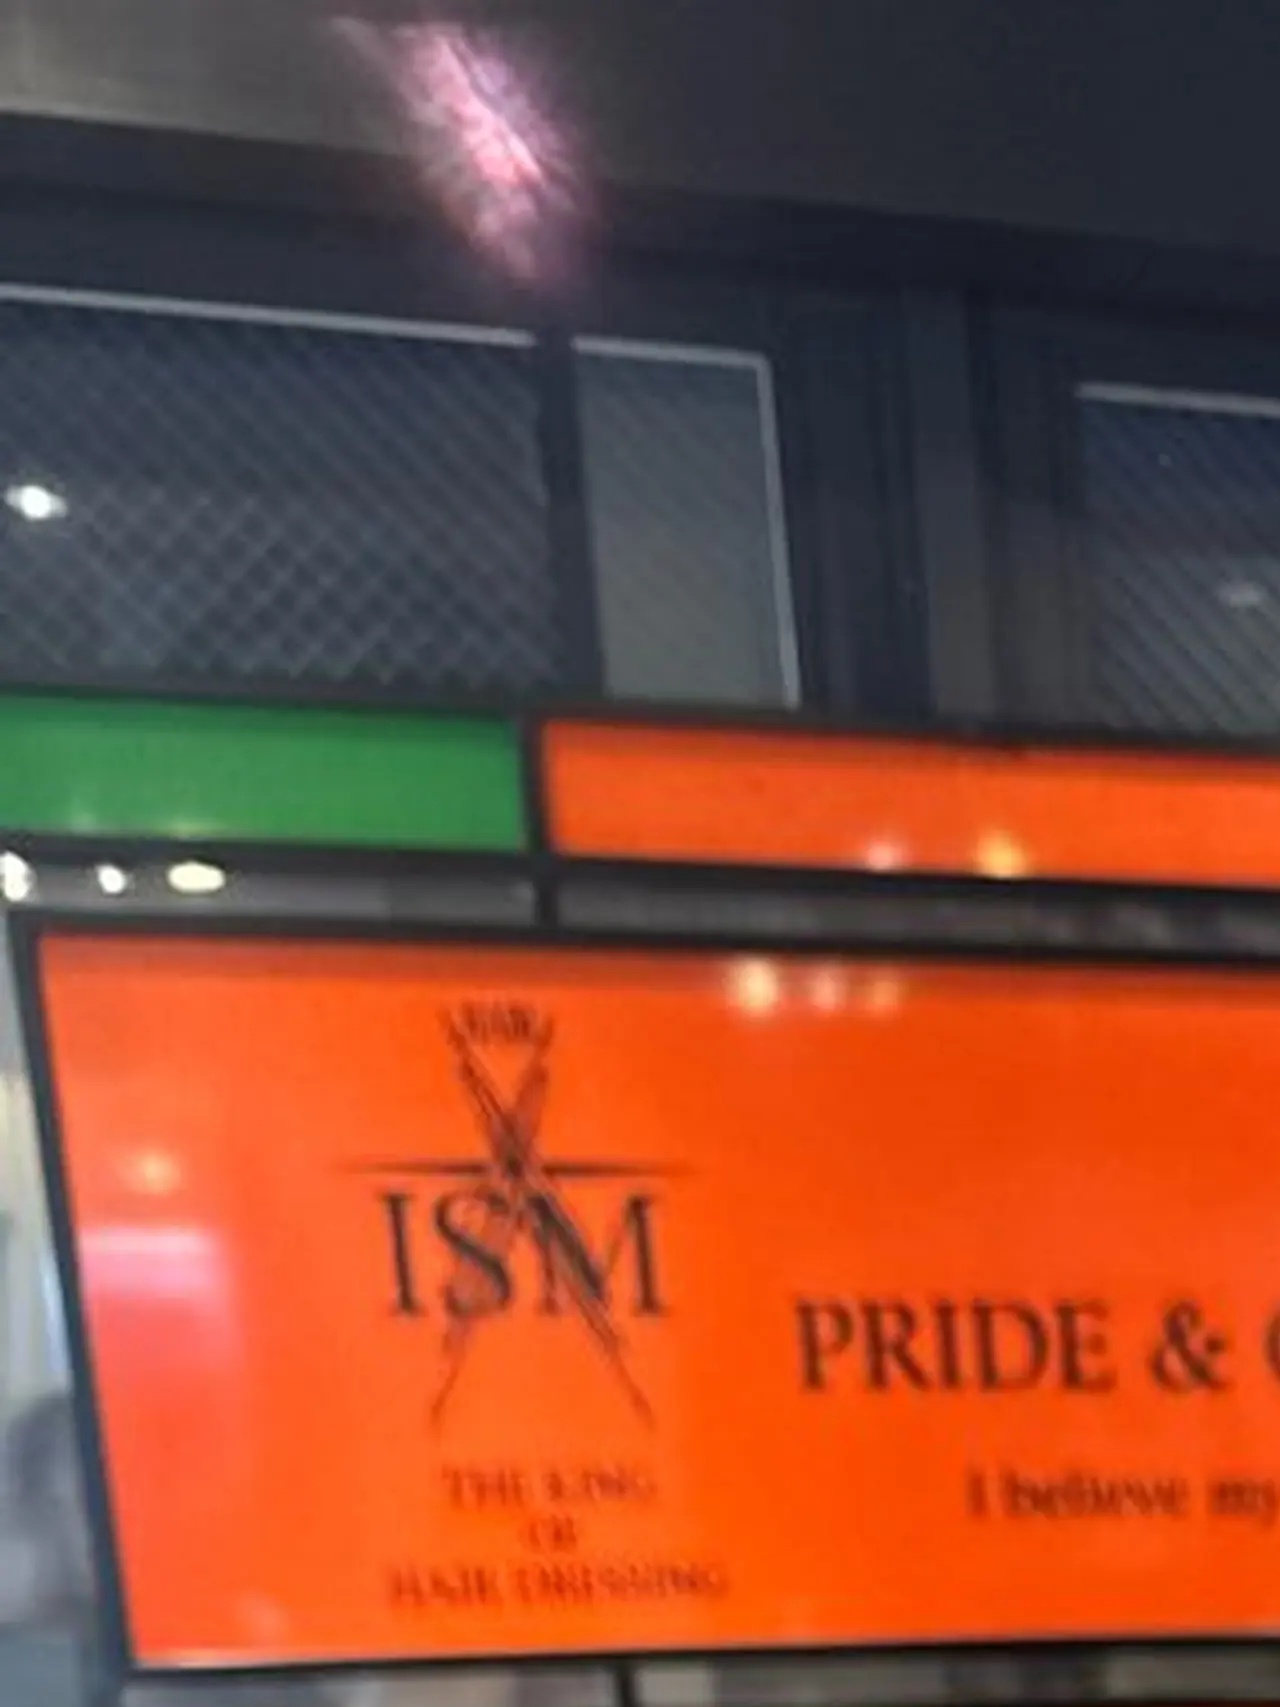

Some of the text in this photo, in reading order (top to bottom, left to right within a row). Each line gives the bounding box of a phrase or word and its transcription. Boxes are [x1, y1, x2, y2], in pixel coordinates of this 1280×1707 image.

[377, 1187, 668, 1317] ISM
[796, 1296, 1117, 1393] PRIDE
[1147, 1299, 1233, 1394] &
[966, 1465, 989, 1518] I
[1000, 1463, 1189, 1519] believe
